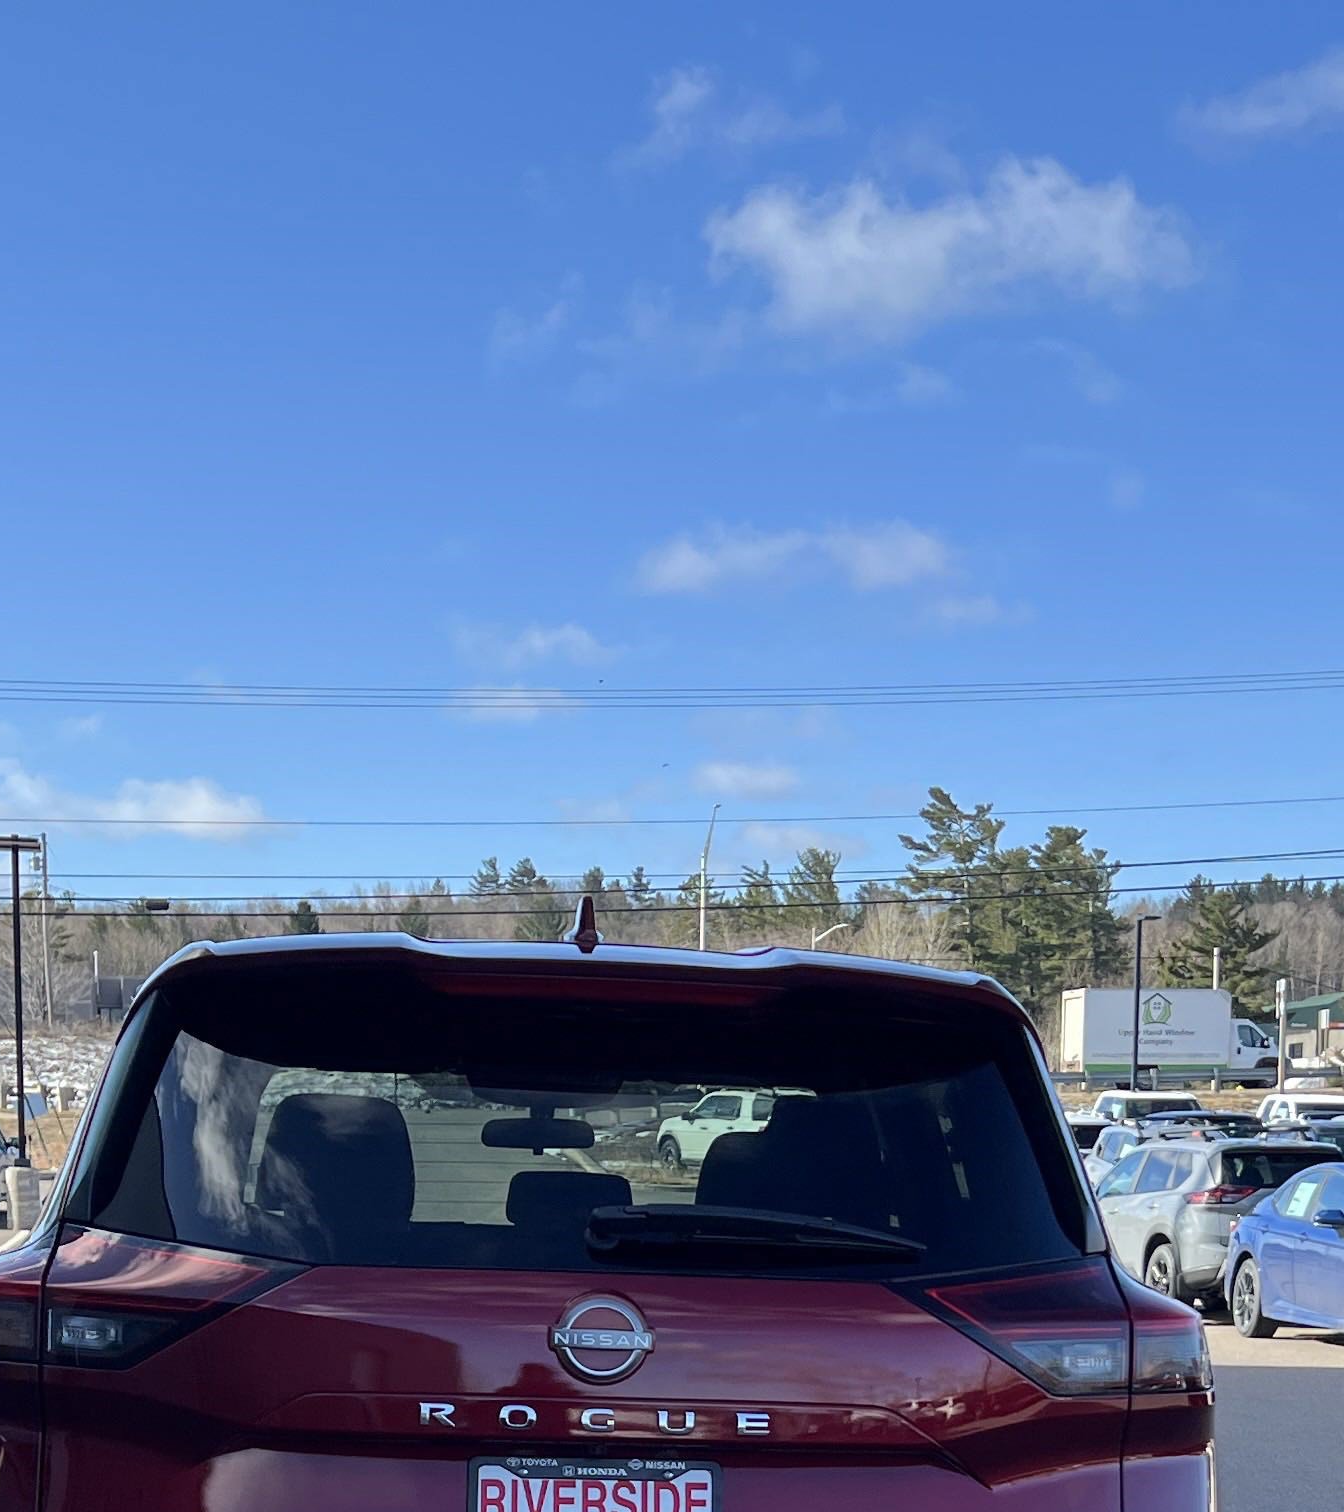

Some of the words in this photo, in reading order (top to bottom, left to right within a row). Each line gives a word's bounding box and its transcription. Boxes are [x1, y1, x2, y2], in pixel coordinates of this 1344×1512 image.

[554, 1331, 650, 1348] NISSAN
[419, 1402, 771, 1436] ROGUE
[521, 1458, 559, 1467] TOYOTA
[645, 1460, 686, 1470] NISSAN
[577, 1467, 628, 1477] HONDA
